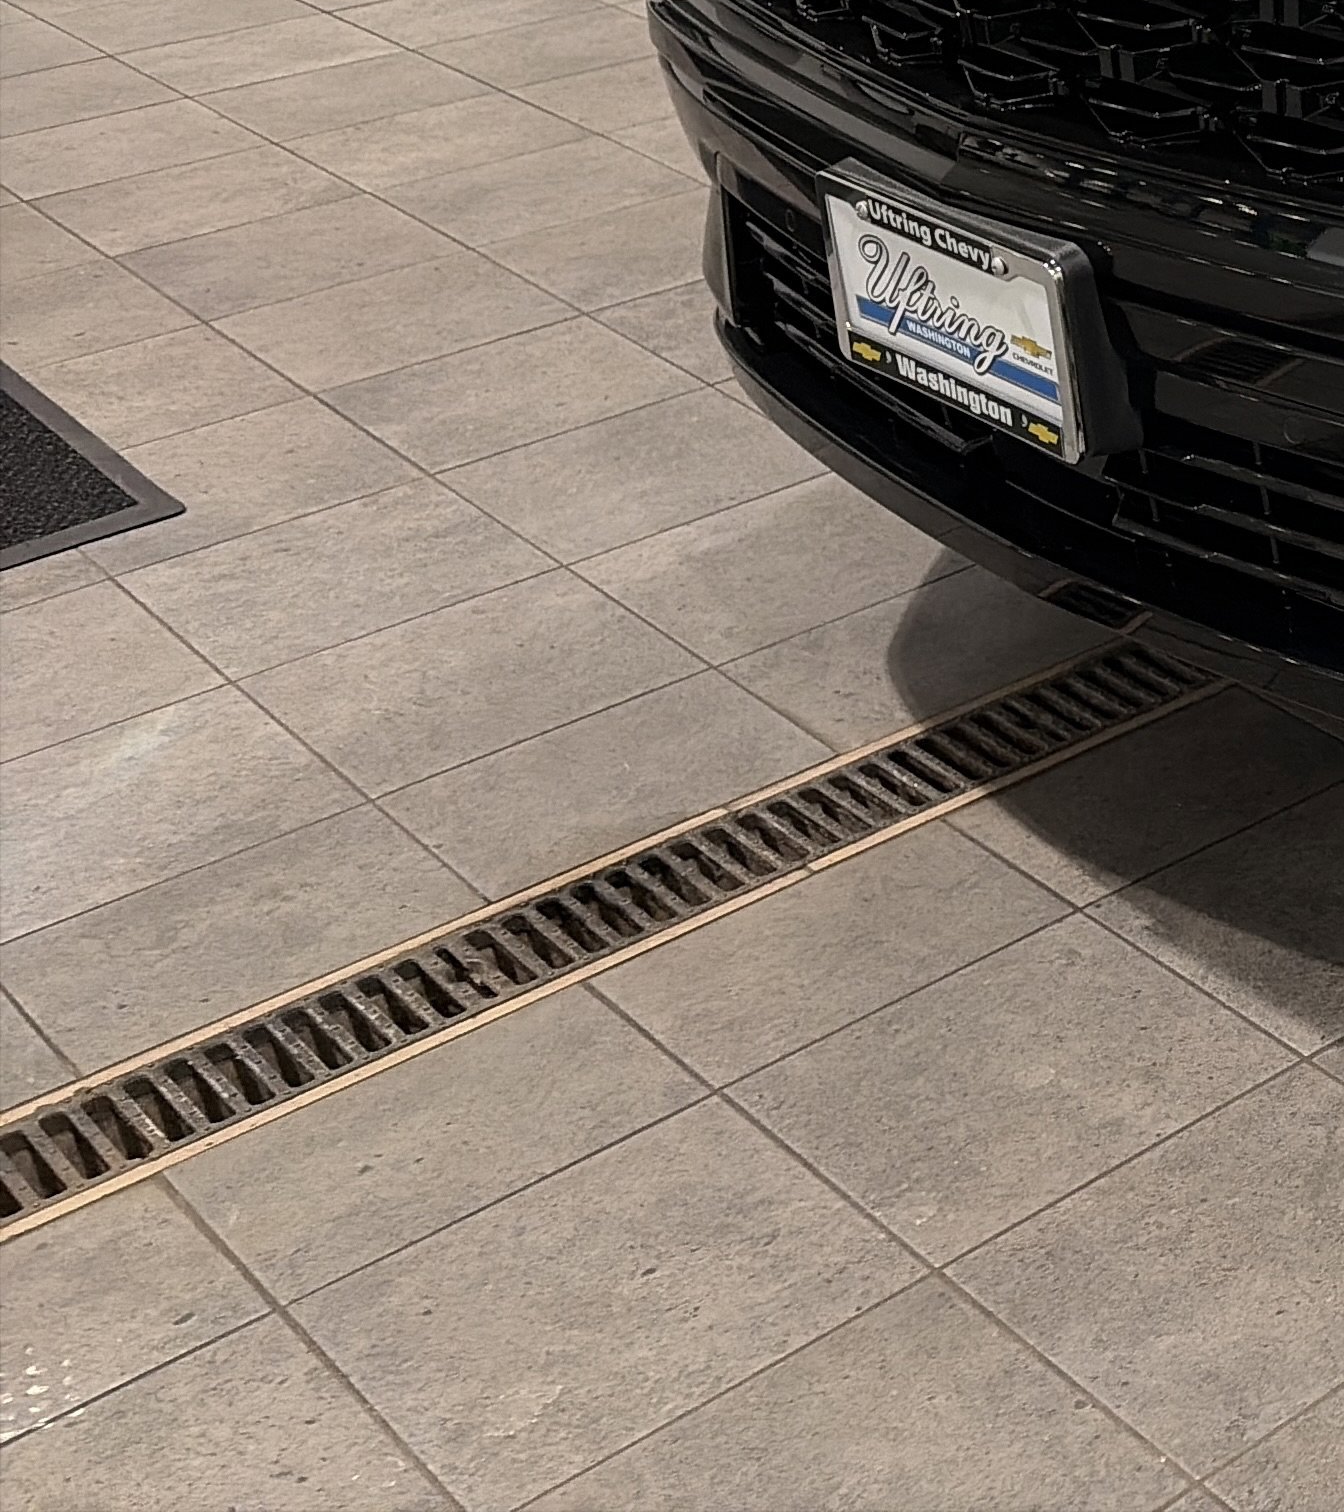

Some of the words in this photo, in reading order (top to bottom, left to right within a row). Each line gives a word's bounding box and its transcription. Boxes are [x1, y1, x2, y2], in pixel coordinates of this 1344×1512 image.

[868, 198, 932, 246] Uftring
[935, 229, 992, 271] Chevy
[858, 233, 1009, 376] Uftring
[905, 320, 971, 359] WASHINGTON
[896, 354, 1014, 427] Washington
[1012, 351, 1055, 376] CHEVROLET
